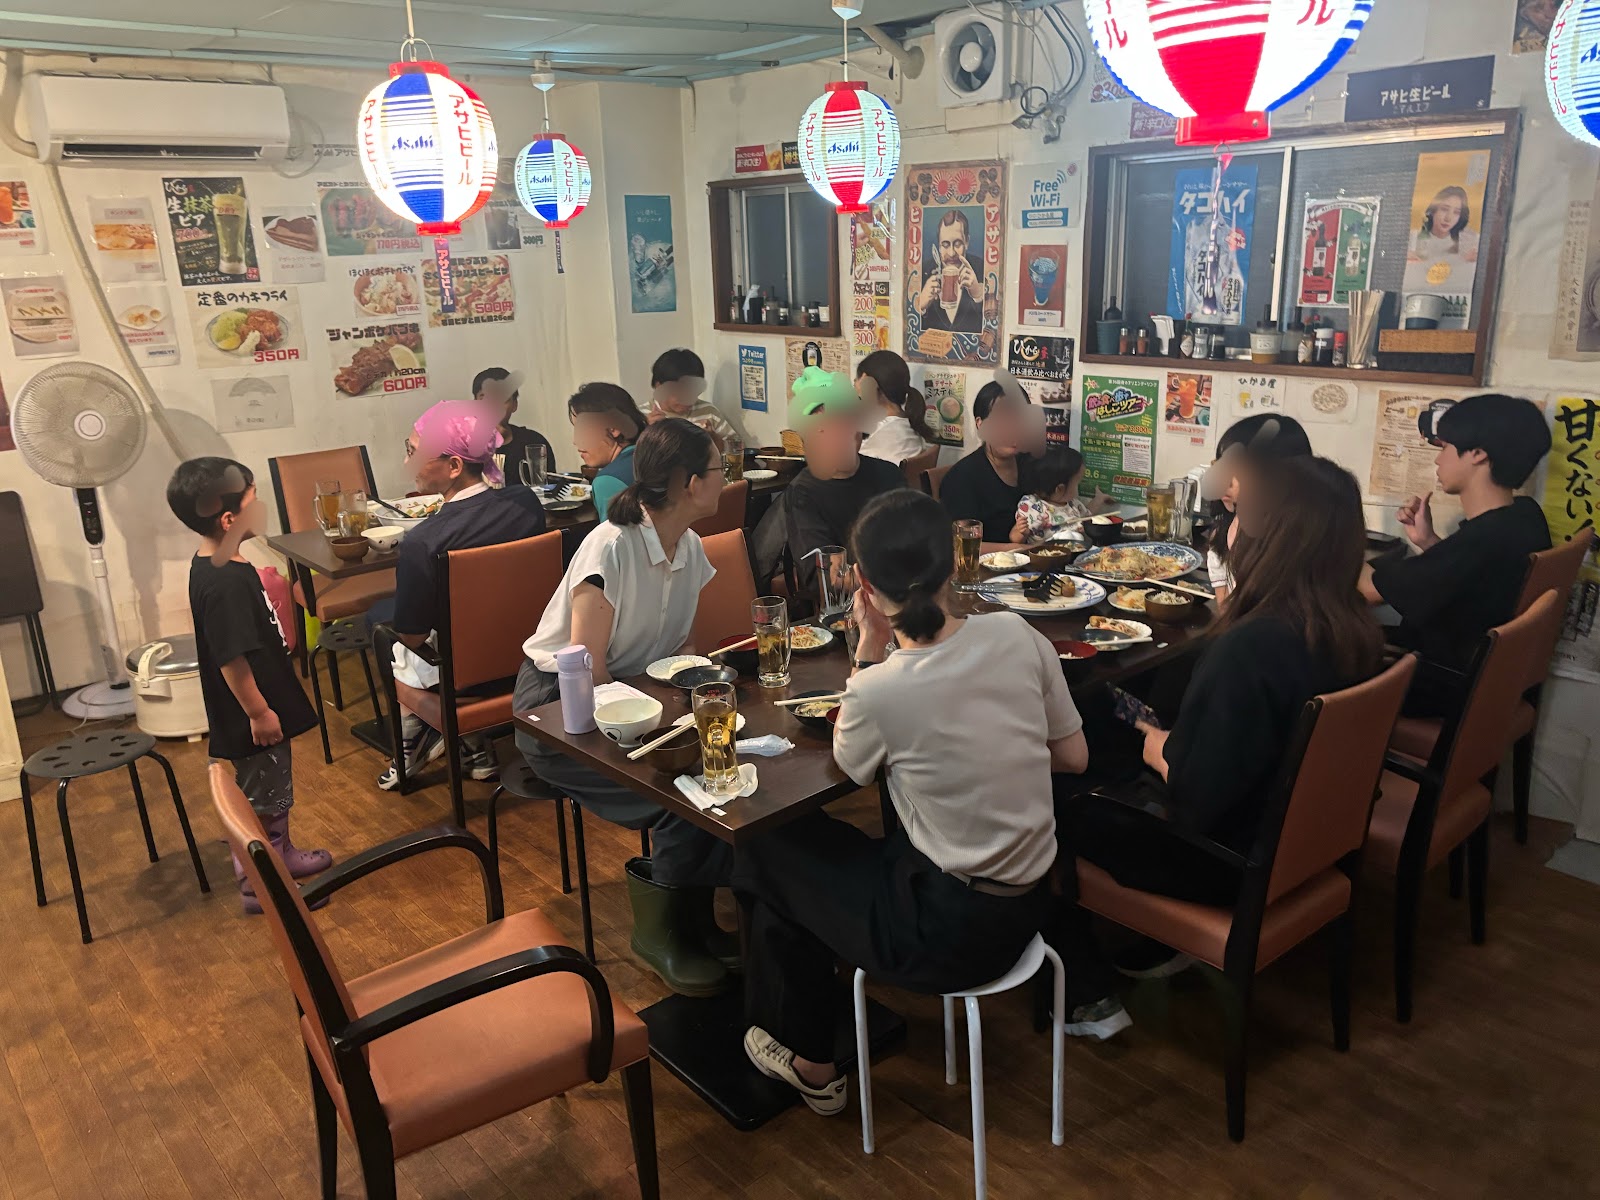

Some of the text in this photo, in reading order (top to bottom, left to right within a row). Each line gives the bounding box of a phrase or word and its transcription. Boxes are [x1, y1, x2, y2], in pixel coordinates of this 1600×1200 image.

[1381, 83, 1451, 106] アサヒ生ビール
[363, 99, 388, 190] アサヒビール
[391, 135, 434, 150] Asahi
[449, 94, 474, 185] アサヒビール
[805, 113, 821, 181] アサヒビール
[827, 141, 859, 154] Asahi
[871, 109, 886, 177] アサヒビール
[530, 175, 553, 184] Asahi
[561, 152, 574, 203] アサヒビール
[1033, 179, 1059, 193] Free
[167, 194, 214, 214] 生抹茶
[1030, 192, 1061, 207] Wi-Fi
[1179, 190, 1250, 215] タコハイ
[178, 213, 206, 227] ビア
[910, 207, 922, 263] ビール
[986, 205, 1000, 264] アサヒ
[437, 249, 454, 305] アサヒビール
[197, 289, 288, 307] 定番のカキフライ
[475, 301, 514, 313] 500円
[326, 322, 420, 341] ジャンボケバブ串
[253, 348, 300, 363] 350円
[748, 350, 765, 359] Twitter
[383, 376, 428, 392] 600円
[1097, 398, 1142, 415] はしごツアー
[1084, 468, 1100, 479] 9.6
[1554, 399, 1600, 541] 甘くない!
